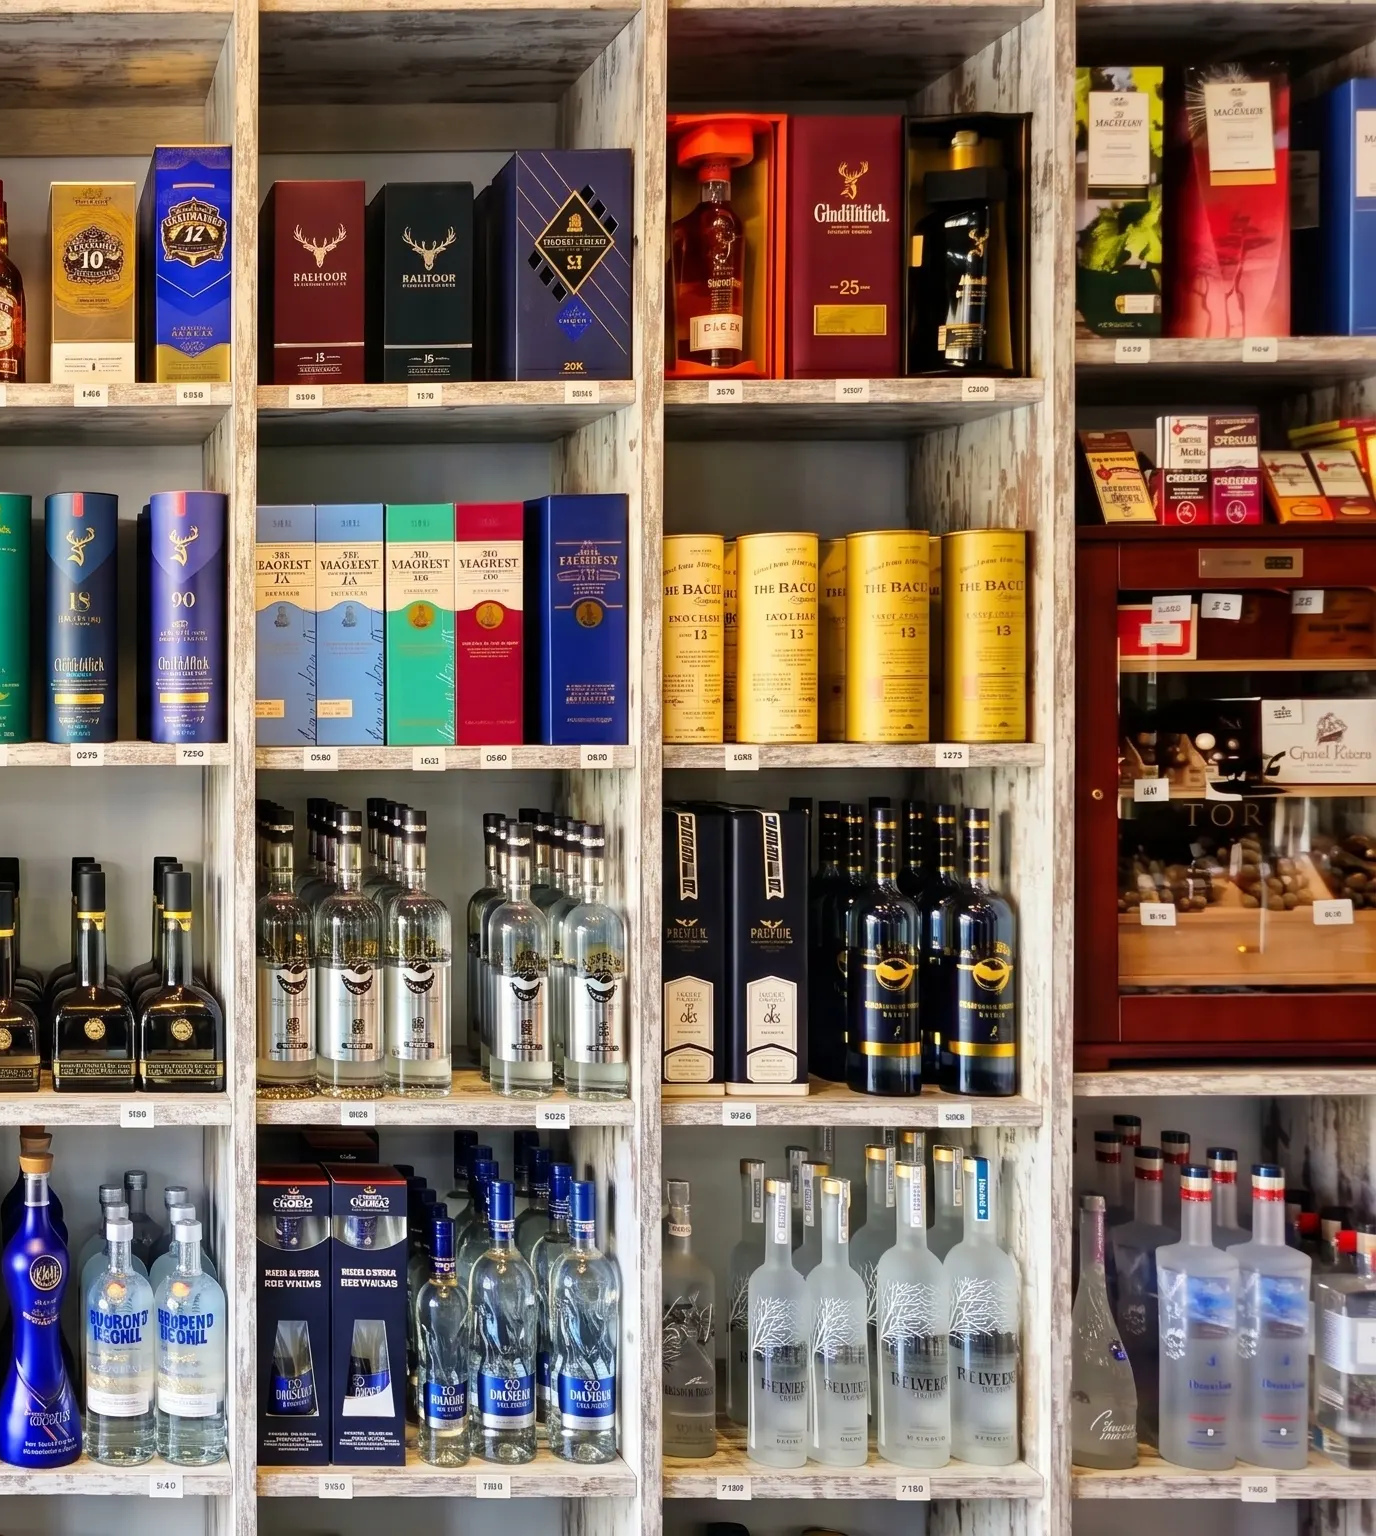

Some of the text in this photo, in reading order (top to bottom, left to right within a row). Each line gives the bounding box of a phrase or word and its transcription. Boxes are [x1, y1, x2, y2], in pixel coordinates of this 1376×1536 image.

[183, 225, 207, 243] 12
[81, 250, 104, 269] 10
[839, 279, 860, 295] 25
[754, 585, 775, 595] THE
[959, 582, 981, 592] THE
[171, 591, 196, 608] 90
[790, 628, 804, 639] 13
[900, 627, 916, 638] 13
[996, 625, 1012, 636] 13
